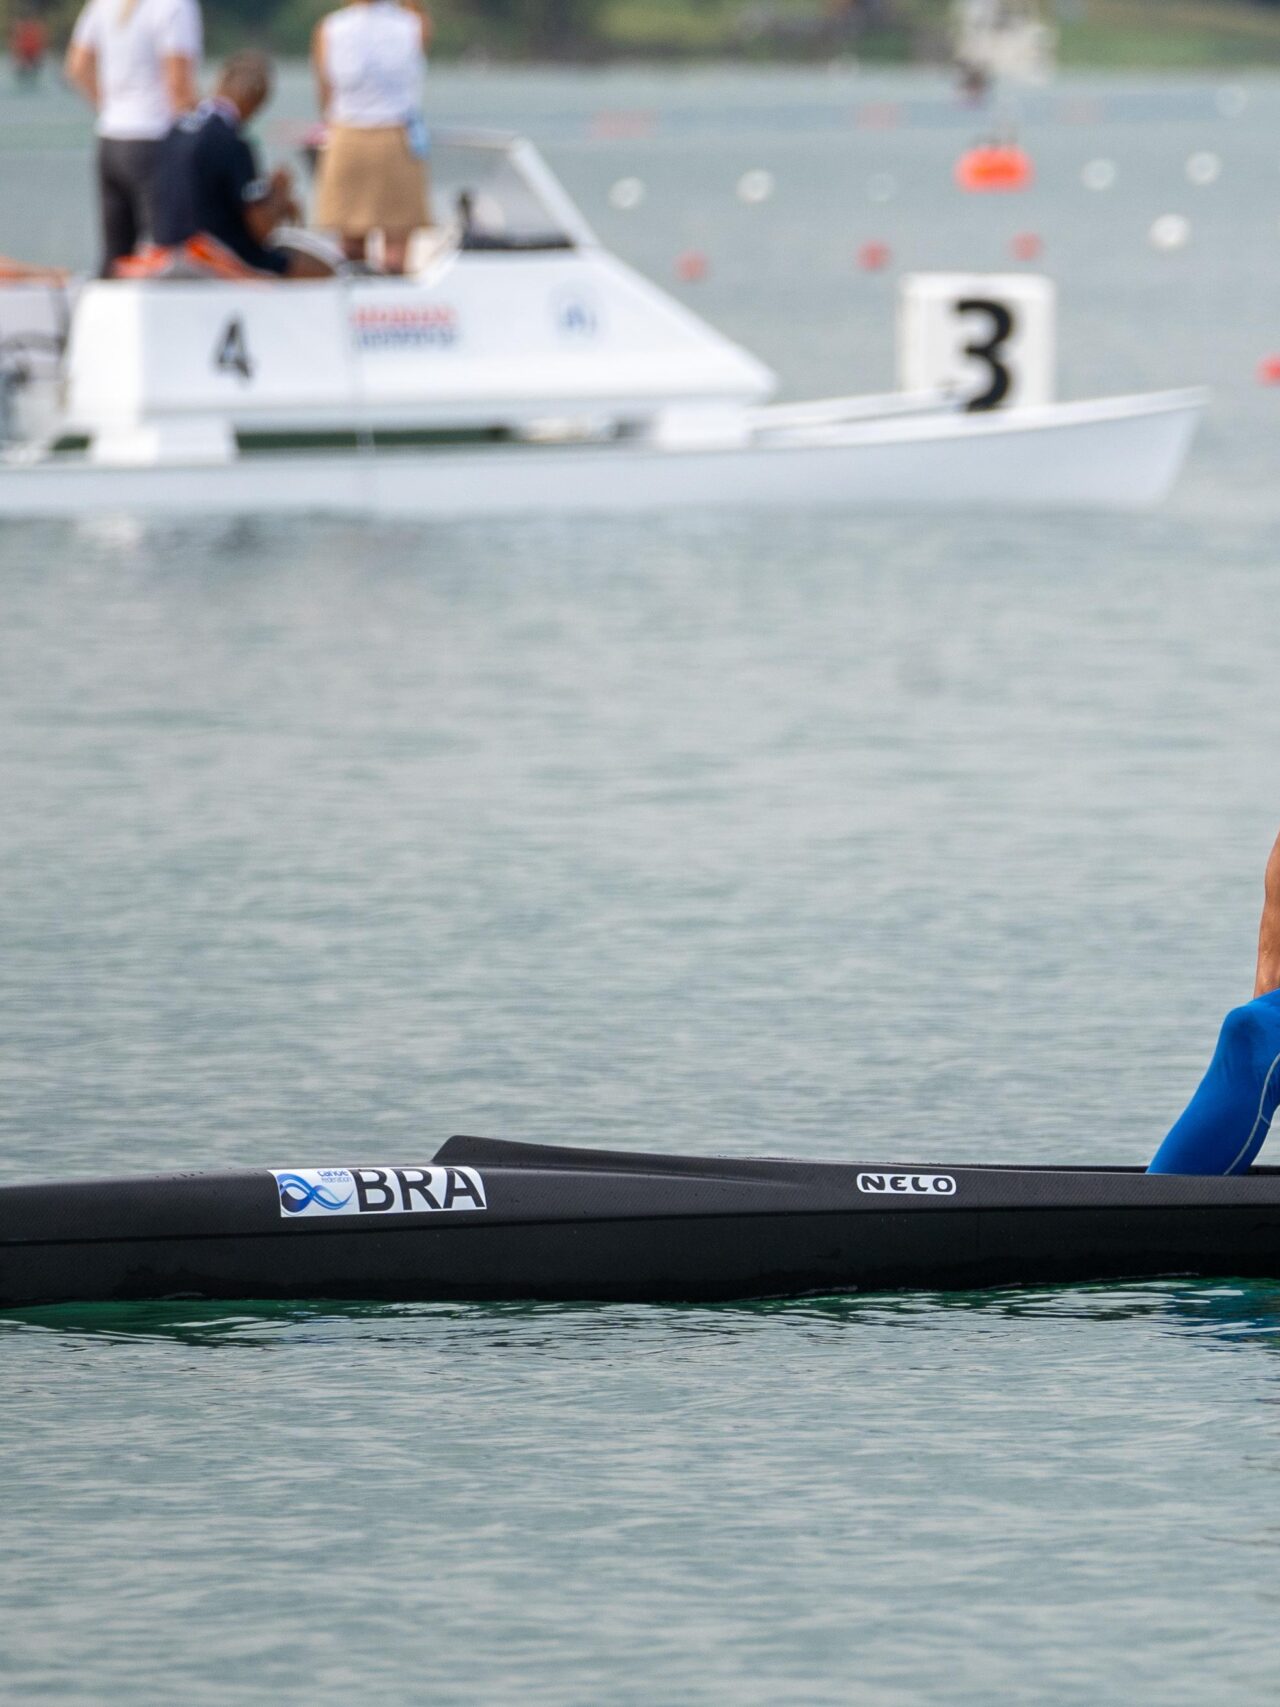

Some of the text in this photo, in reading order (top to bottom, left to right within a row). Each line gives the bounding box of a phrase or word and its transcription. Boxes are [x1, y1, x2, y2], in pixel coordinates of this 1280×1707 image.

[213, 314, 254, 381] 4
[954, 298, 1012, 413] 3
[350, 1168, 486, 1212] BRA
[861, 1175, 953, 1193] NELO
